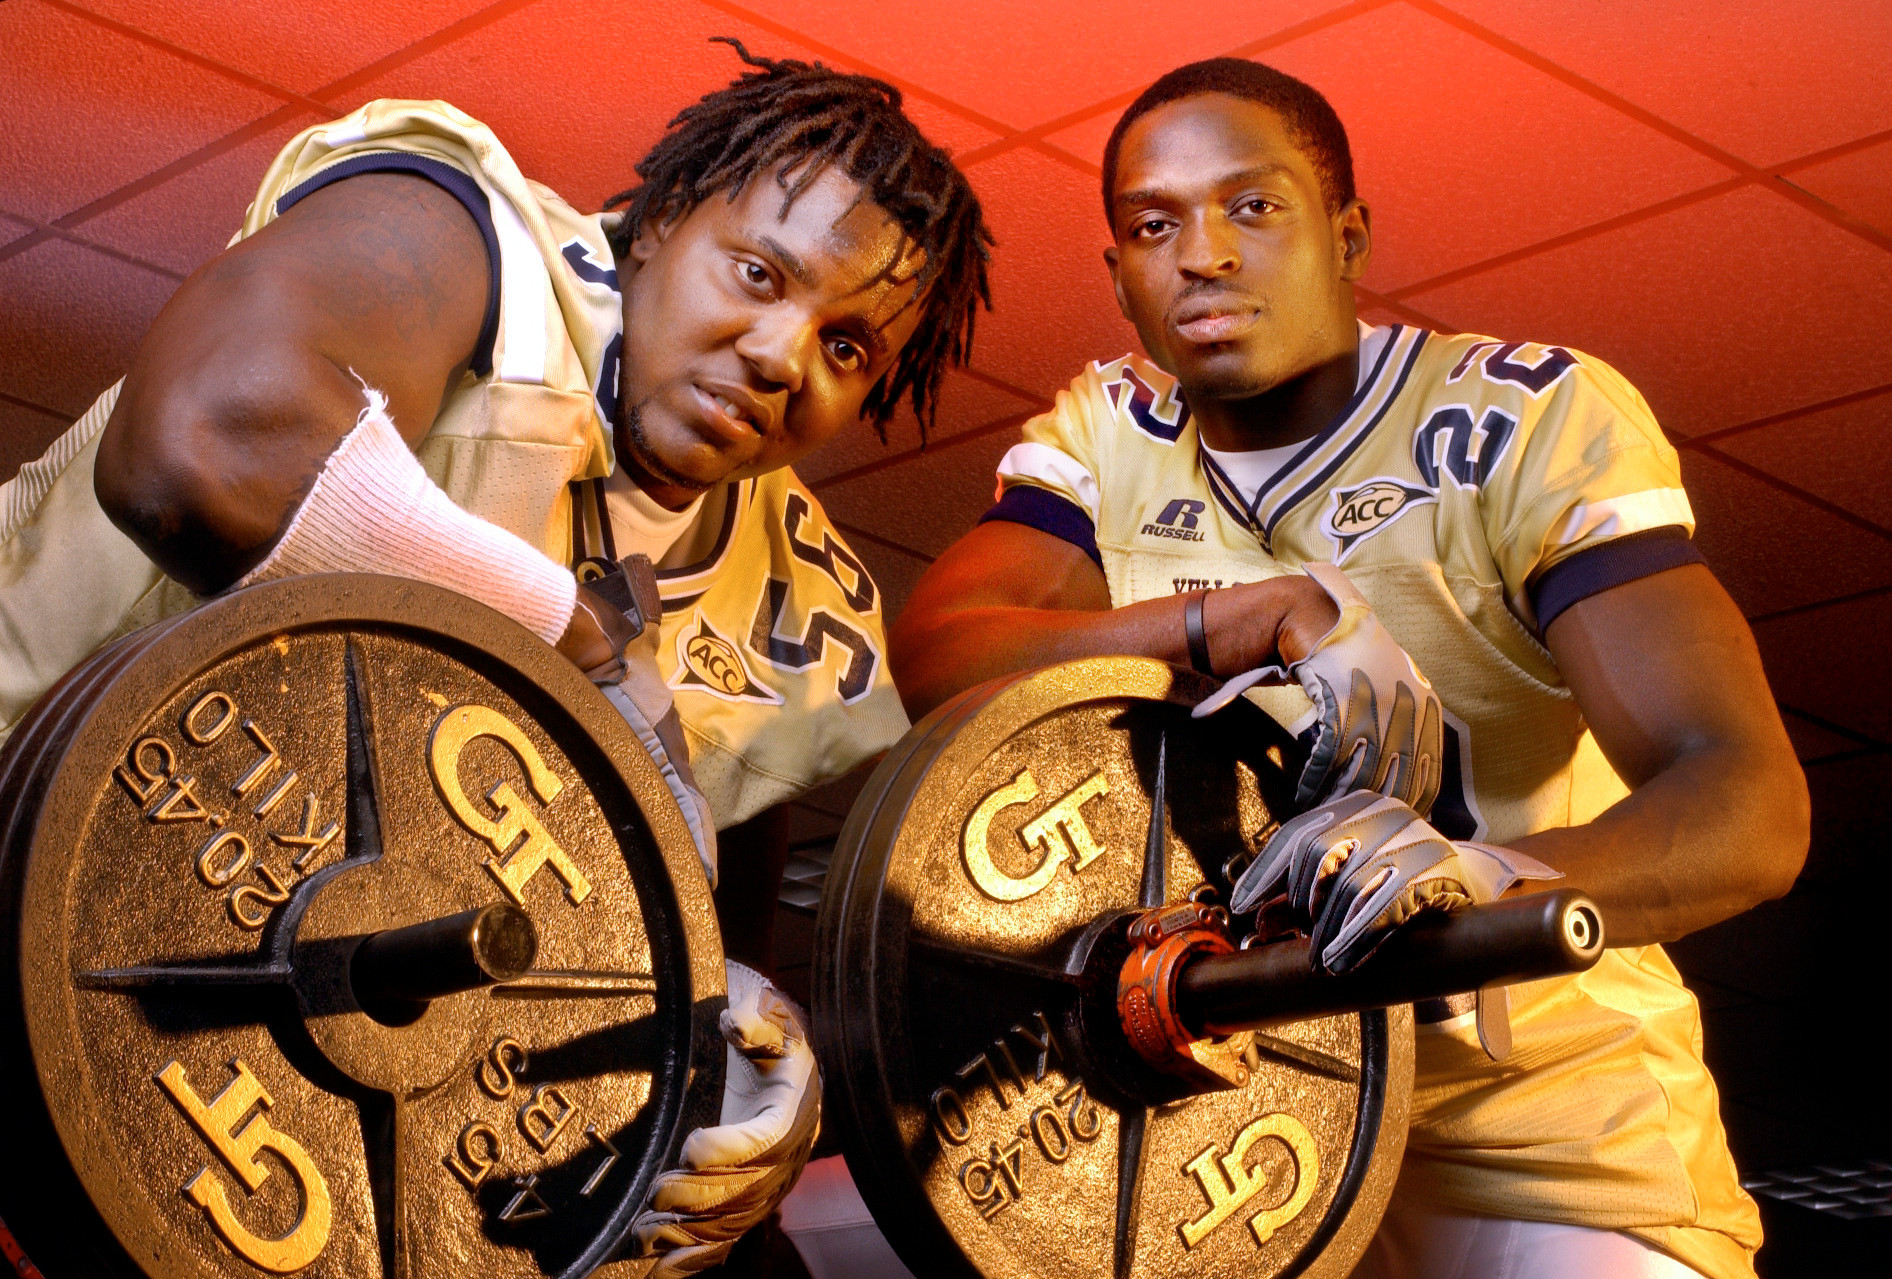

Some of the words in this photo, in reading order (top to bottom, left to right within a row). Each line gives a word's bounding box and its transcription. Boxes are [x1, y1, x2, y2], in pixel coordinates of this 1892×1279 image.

[1140, 523, 1206, 542] RUSSELL
[1337, 497, 1394, 528] ACC
[690, 644, 739, 692] ACC
[180, 690, 342, 868] KILO
[426, 703, 593, 906] GT
[960, 764, 1111, 903] GT
[930, 1010, 1065, 1146] KILO
[153, 1057, 332, 1274] GT
[959, 1076, 1102, 1221] 20.45
[1177, 1112, 1320, 1250] GT
